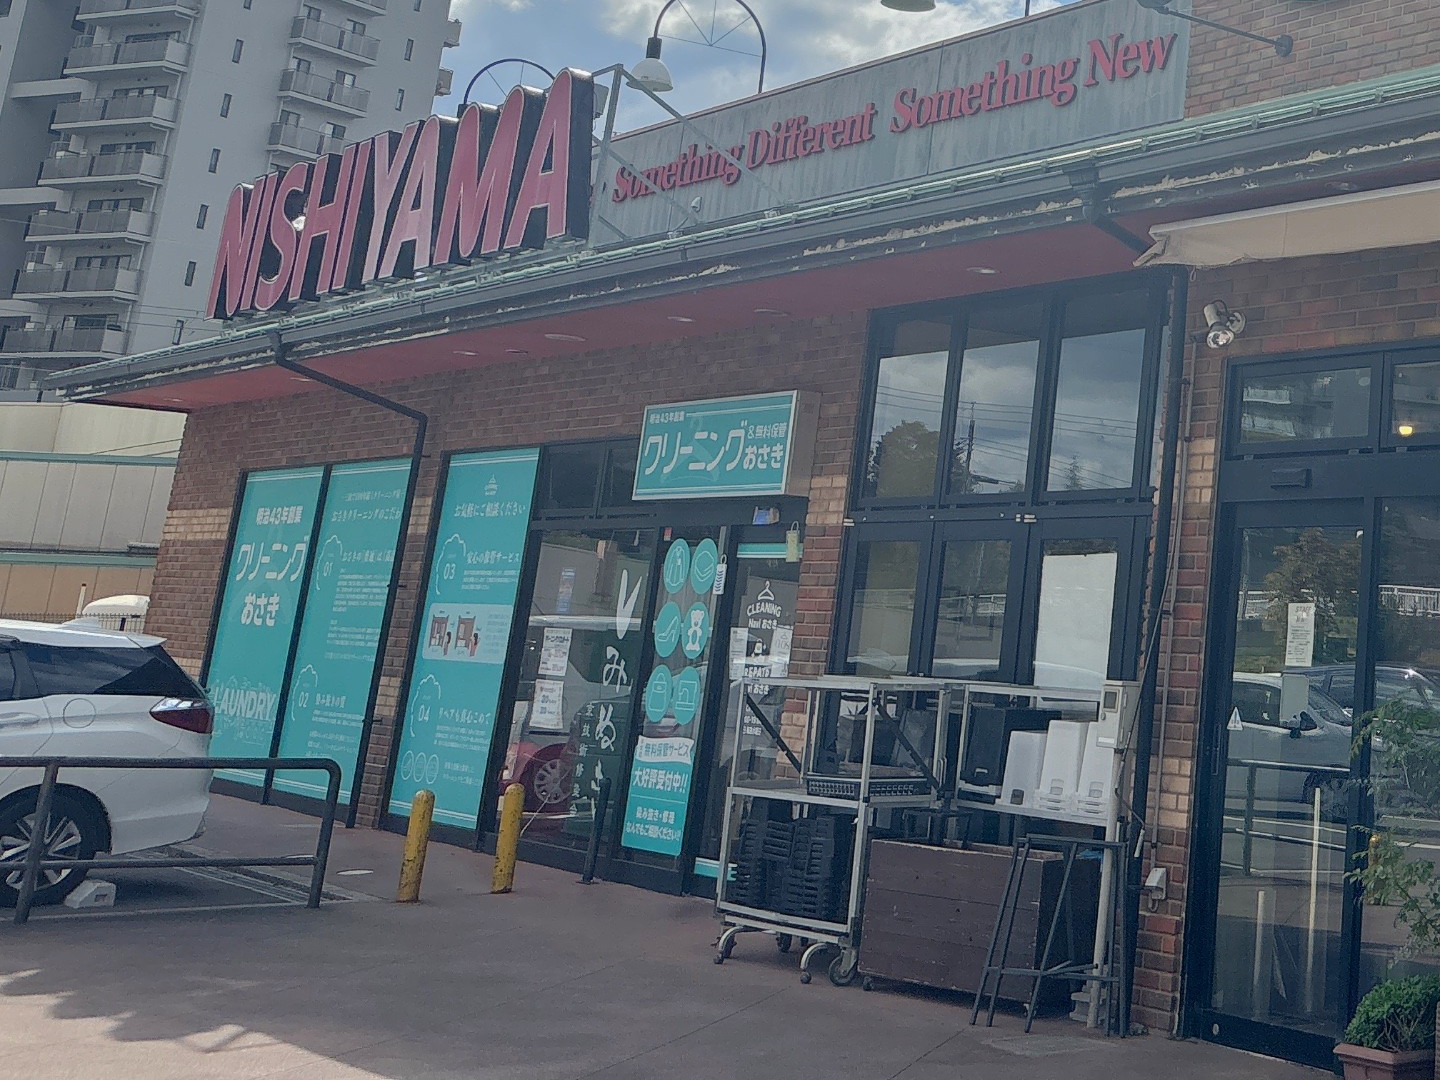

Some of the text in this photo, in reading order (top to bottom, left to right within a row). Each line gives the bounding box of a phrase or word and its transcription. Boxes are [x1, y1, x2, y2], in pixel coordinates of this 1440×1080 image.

[612, 33, 1178, 203] Something Different Something New
[206, 67, 576, 320] NISHIYAMA
[644, 419, 784, 476] クリーニング おさき
[256, 505, 304, 526] 明治43年創業
[235, 535, 310, 582] クリーニング
[443, 563, 456, 580] 03
[240, 592, 280, 627] おさき
[746, 601, 782, 618] CLEANING
[213, 686, 277, 721] LAUNDRY
[299, 692, 309, 708] 02
[418, 704, 431, 723] 04
